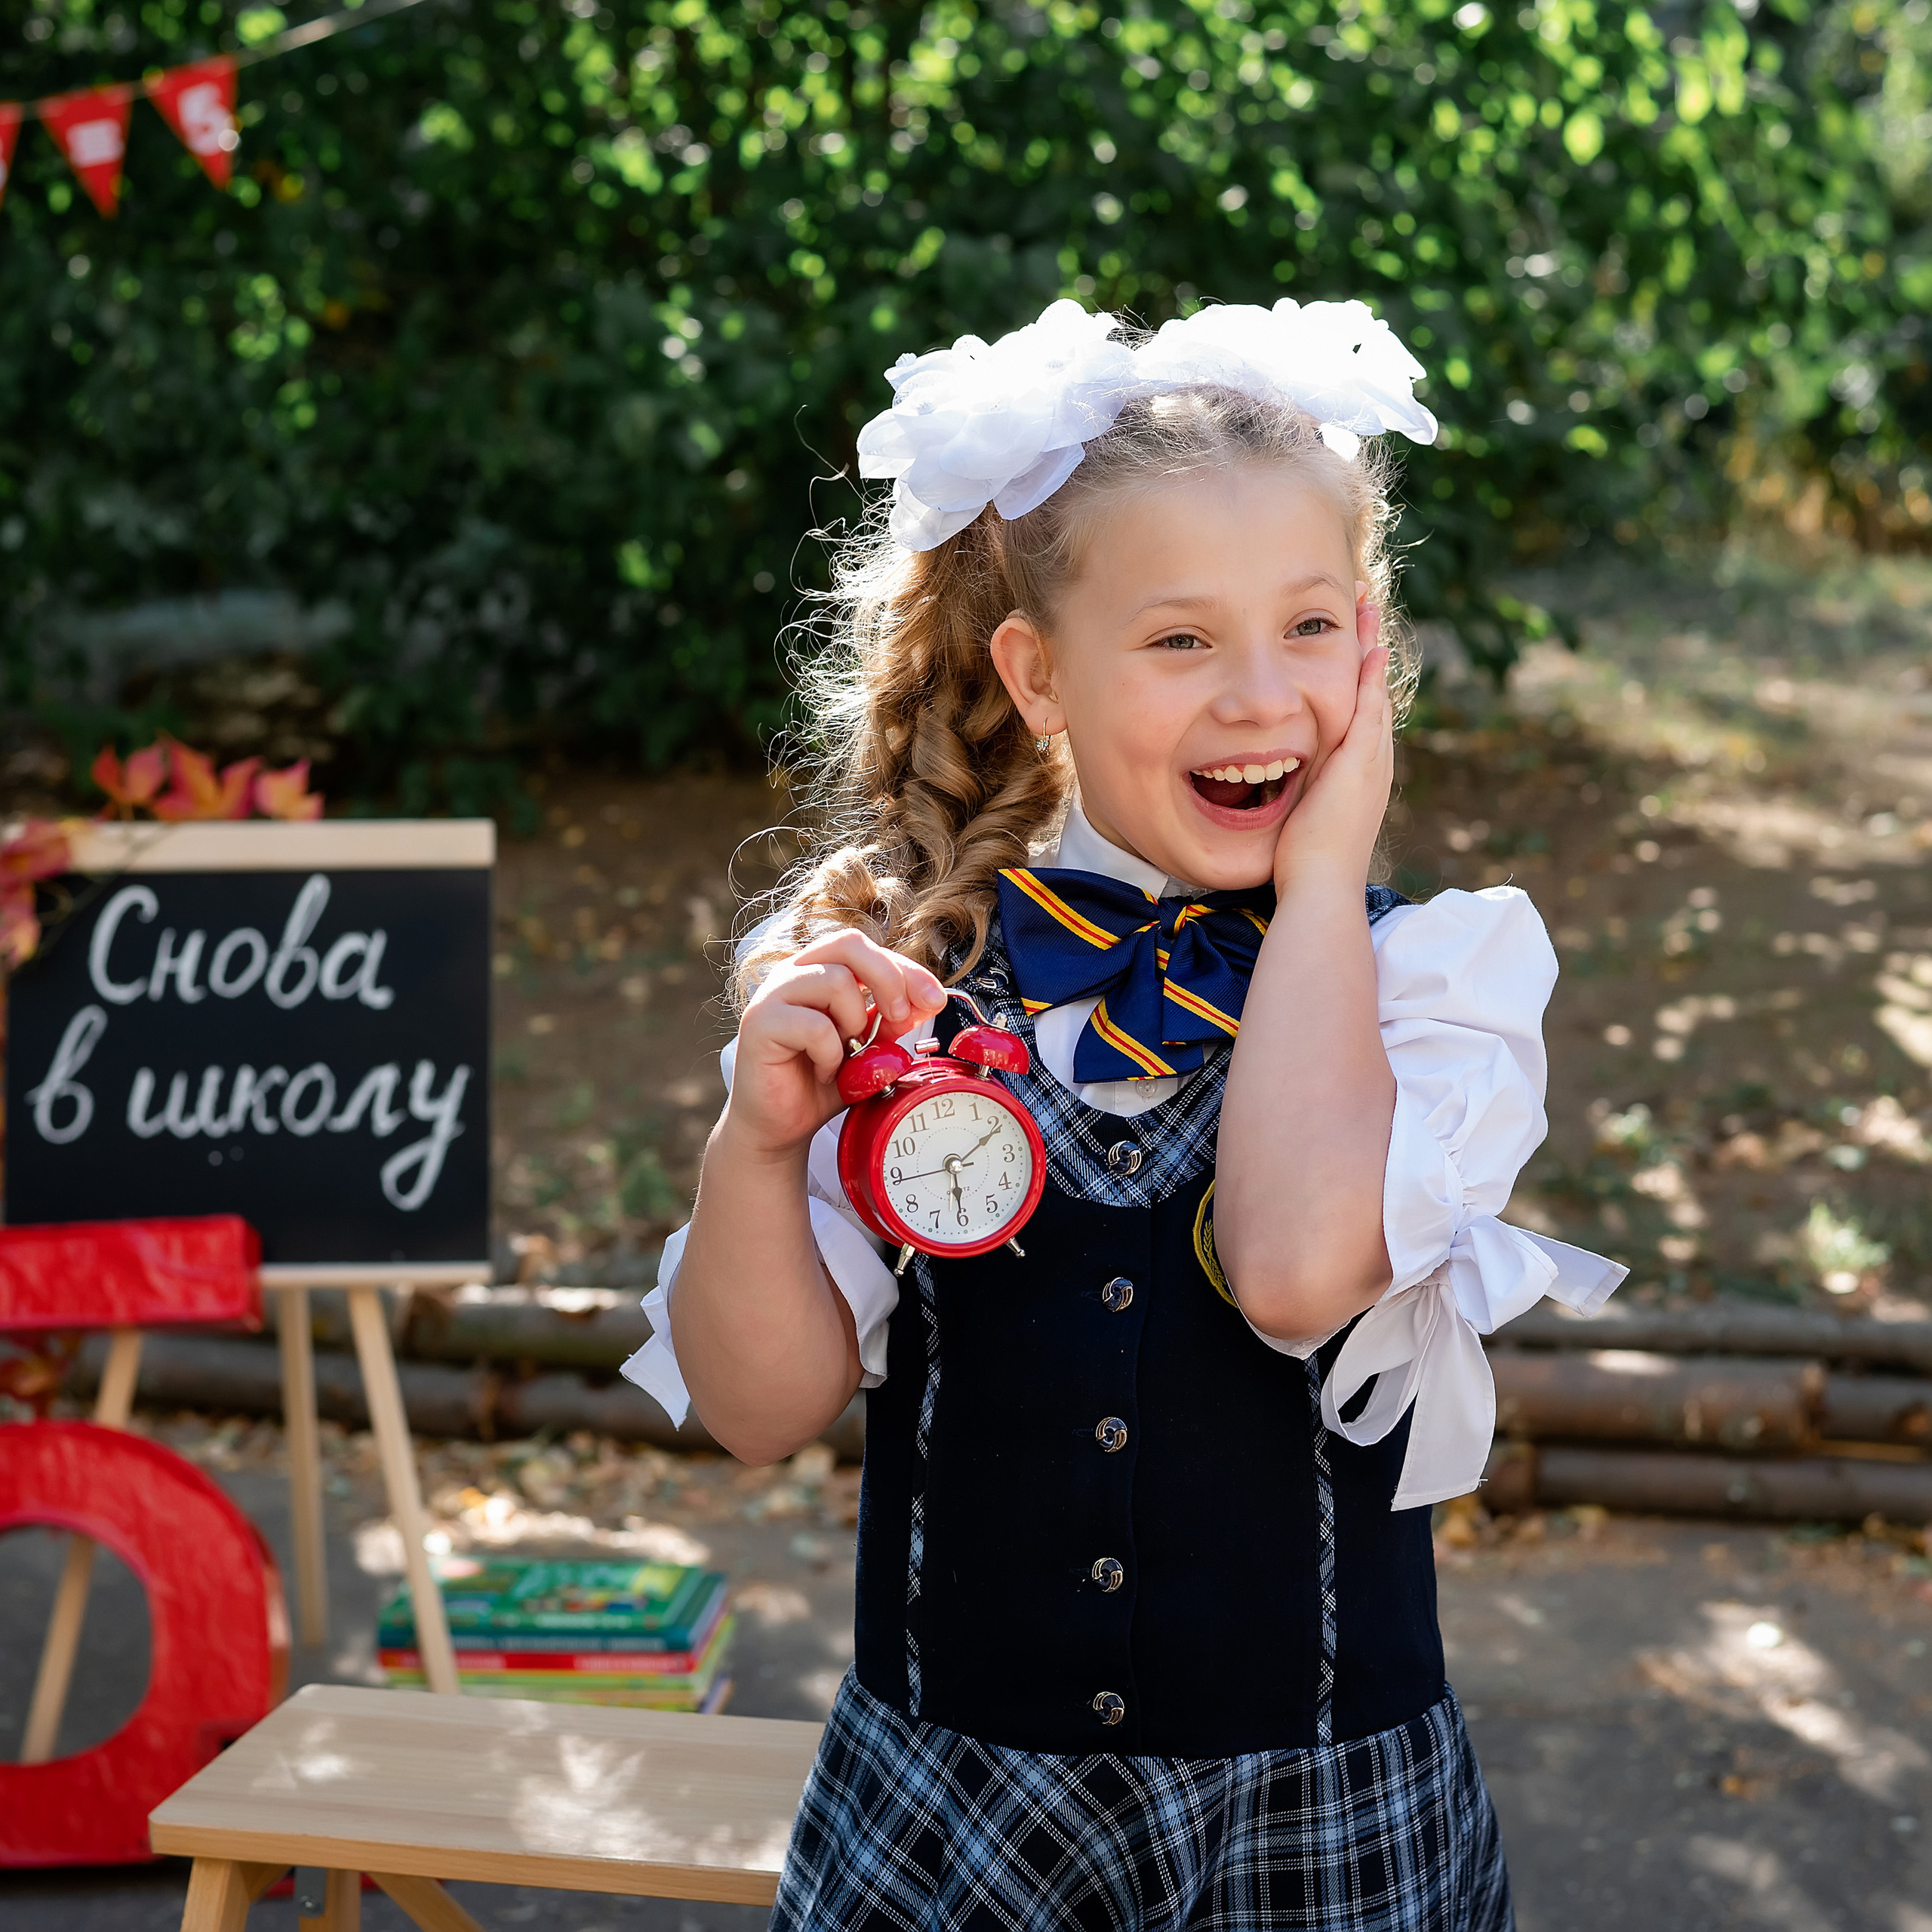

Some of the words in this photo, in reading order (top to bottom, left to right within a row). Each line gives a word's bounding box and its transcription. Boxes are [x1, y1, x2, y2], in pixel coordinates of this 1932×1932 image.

[88, 873, 395, 1010] Снова
[25, 1004, 108, 1144] в
[126, 1059, 473, 1211] школу
[931, 1098, 955, 1121] 12
[969, 1103, 983, 1121] 1
[907, 1112, 929, 1134] 11
[987, 1116, 1003, 1135] 2
[891, 1137, 915, 1158] 10
[1002, 1144, 1015, 1162] 3
[891, 1167, 903, 1186] 9
[998, 1172, 1012, 1190] 4
[906, 1194, 918, 1213] 8
[986, 1194, 998, 1213] 5
[930, 1210, 940, 1229] 7
[956, 1208, 969, 1226] 6
